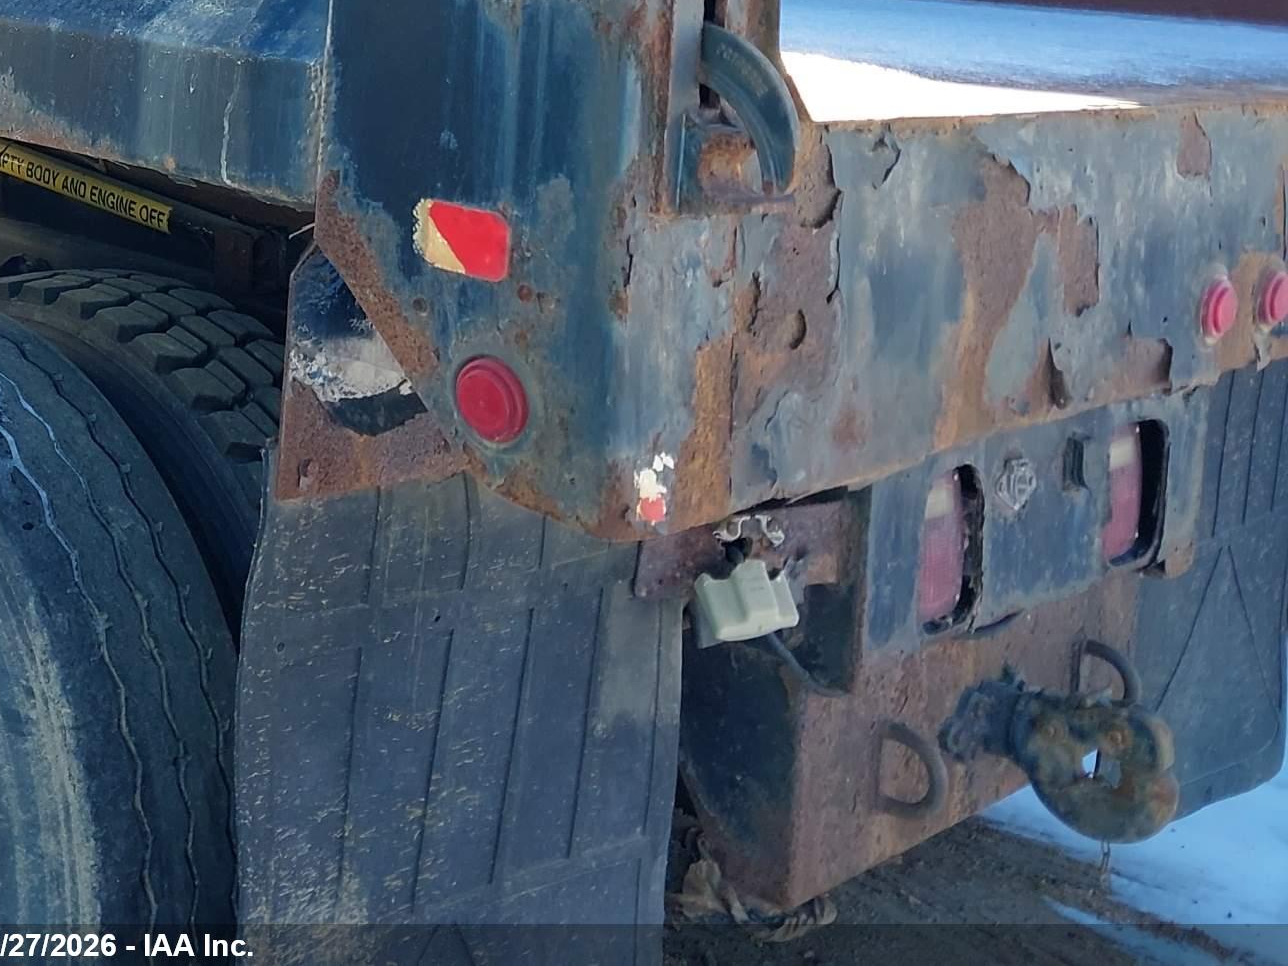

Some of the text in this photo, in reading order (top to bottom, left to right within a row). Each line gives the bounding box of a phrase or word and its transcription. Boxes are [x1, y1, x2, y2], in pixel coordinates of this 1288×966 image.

[25, 161, 60, 188] BODY
[61, 175, 88, 199] AND
[89, 187, 137, 219] ENGINE
[138, 203, 167, 229] OFF
